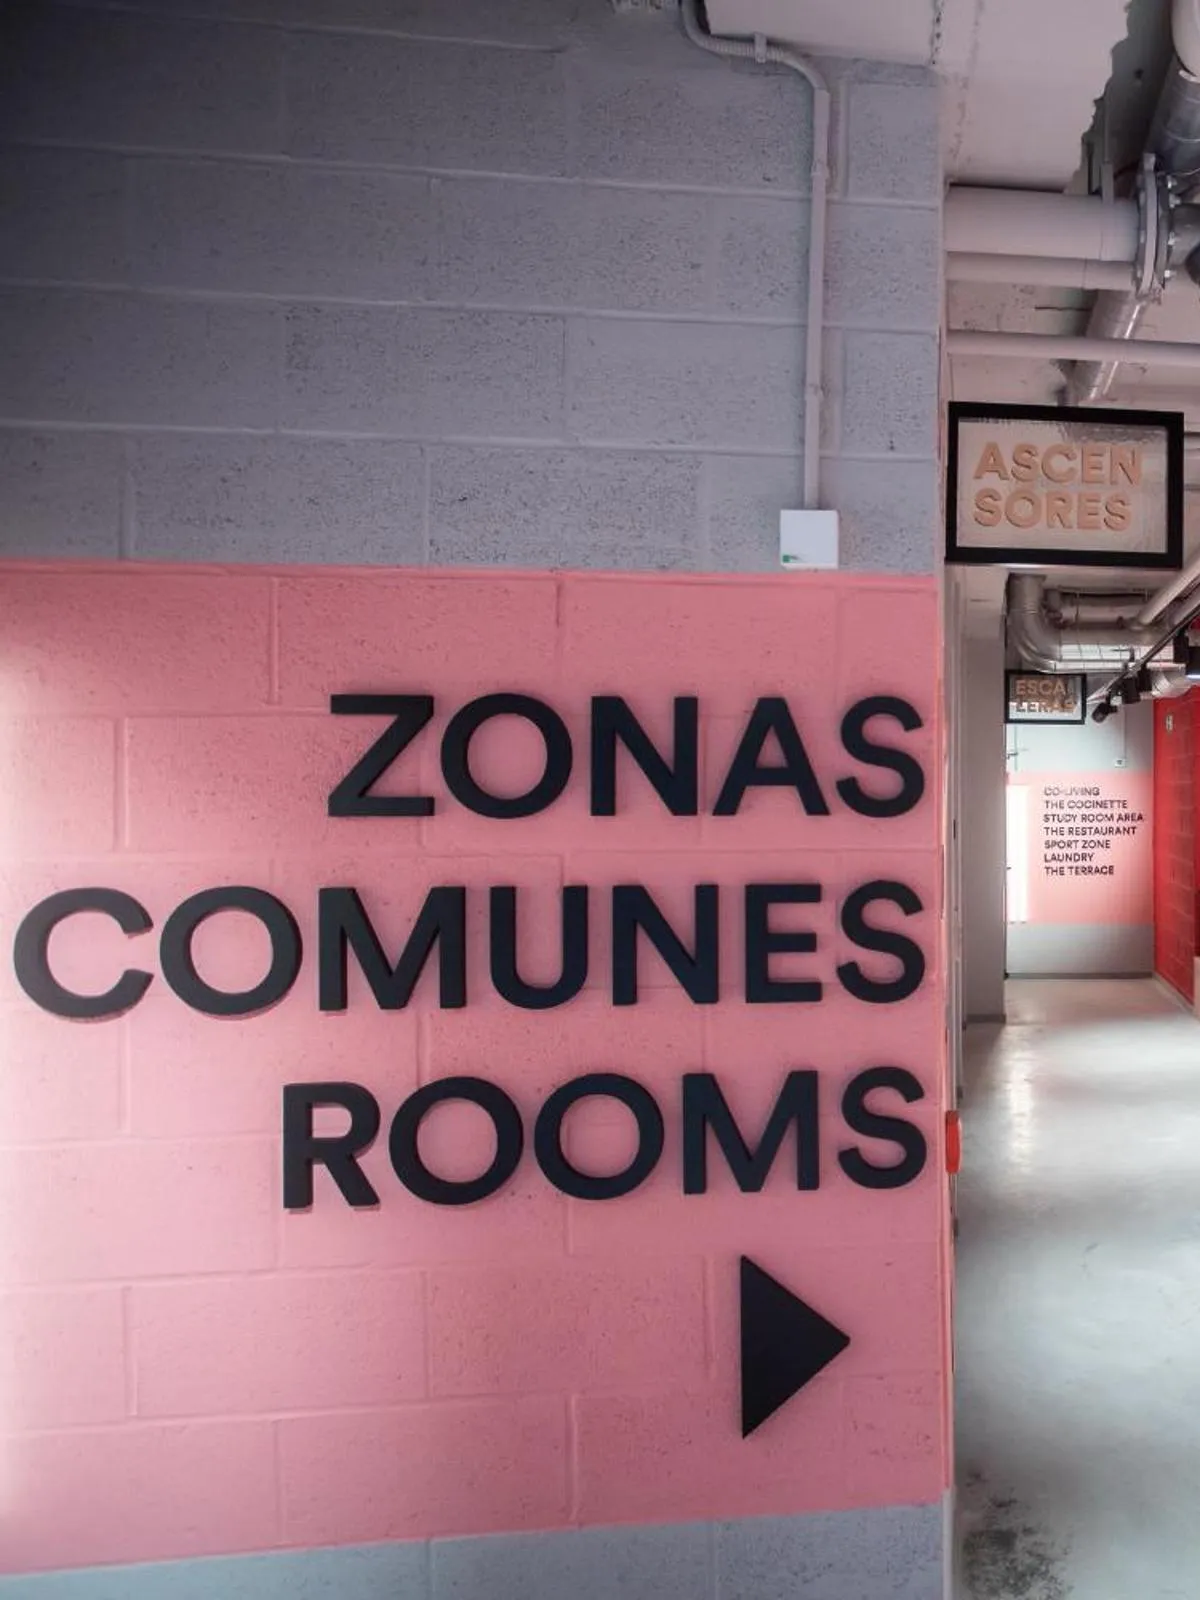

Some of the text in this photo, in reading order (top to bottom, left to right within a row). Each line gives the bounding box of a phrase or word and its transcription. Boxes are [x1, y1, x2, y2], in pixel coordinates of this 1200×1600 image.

[973, 441, 1142, 486] ASCEN
[973, 488, 1131, 532] SORES
[1016, 679, 1066, 695] ESCA
[328, 692, 926, 819] ZONAS
[1044, 799, 1128, 809] THE COCINETTE
[1043, 812, 1144, 823] STUDY ROOM AREA
[1044, 826, 1137, 836] THE RESTAURANT
[1044, 839, 1111, 849] SPORT ZONE
[1044, 852, 1095, 863] LAUNDRY
[1044, 865, 1115, 876] THE TERRACE
[13, 879, 926, 1021] COMUNES
[283, 1065, 928, 1211] ROOMS
